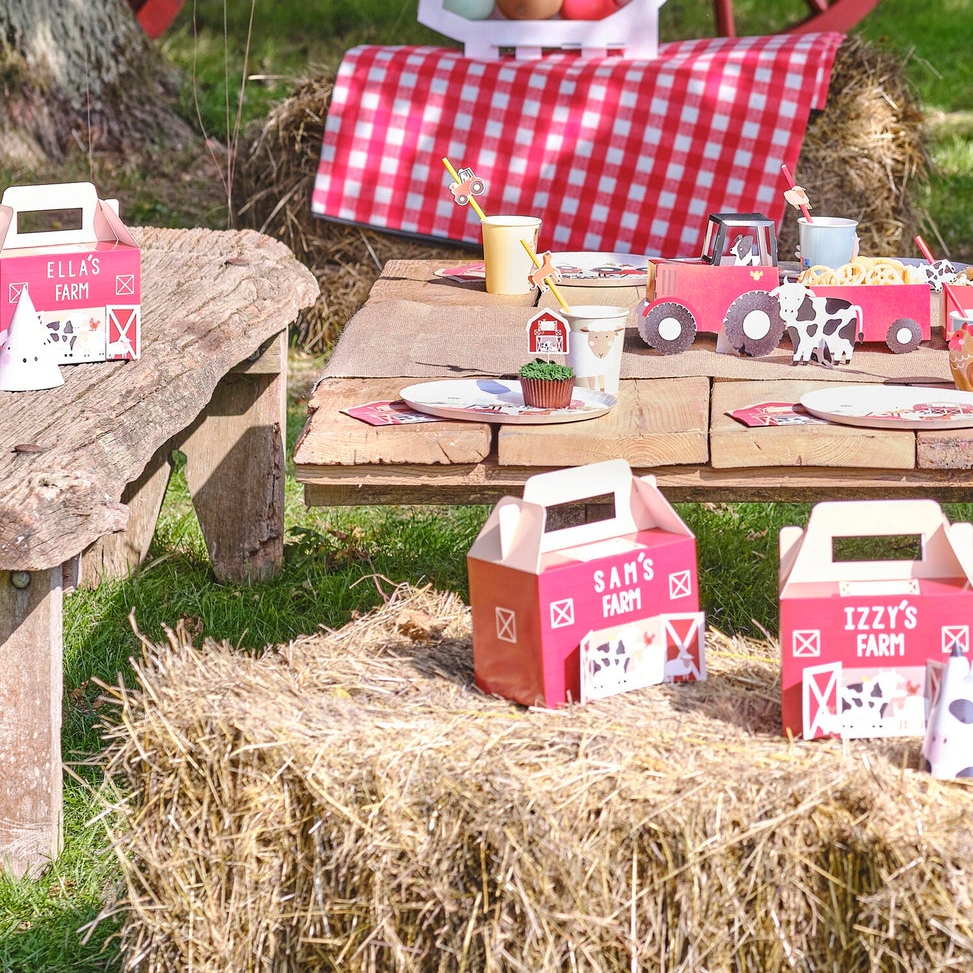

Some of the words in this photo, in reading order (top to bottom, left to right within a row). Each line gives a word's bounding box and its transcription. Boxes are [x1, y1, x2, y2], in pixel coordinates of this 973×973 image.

[47, 254, 101, 279] ELLA'S
[55, 282, 89, 301] FARM
[593, 552, 655, 594] SAM'S
[602, 587, 642, 619] FARM
[843, 599, 918, 631] IZZY'S
[856, 632, 905, 658] FARM
